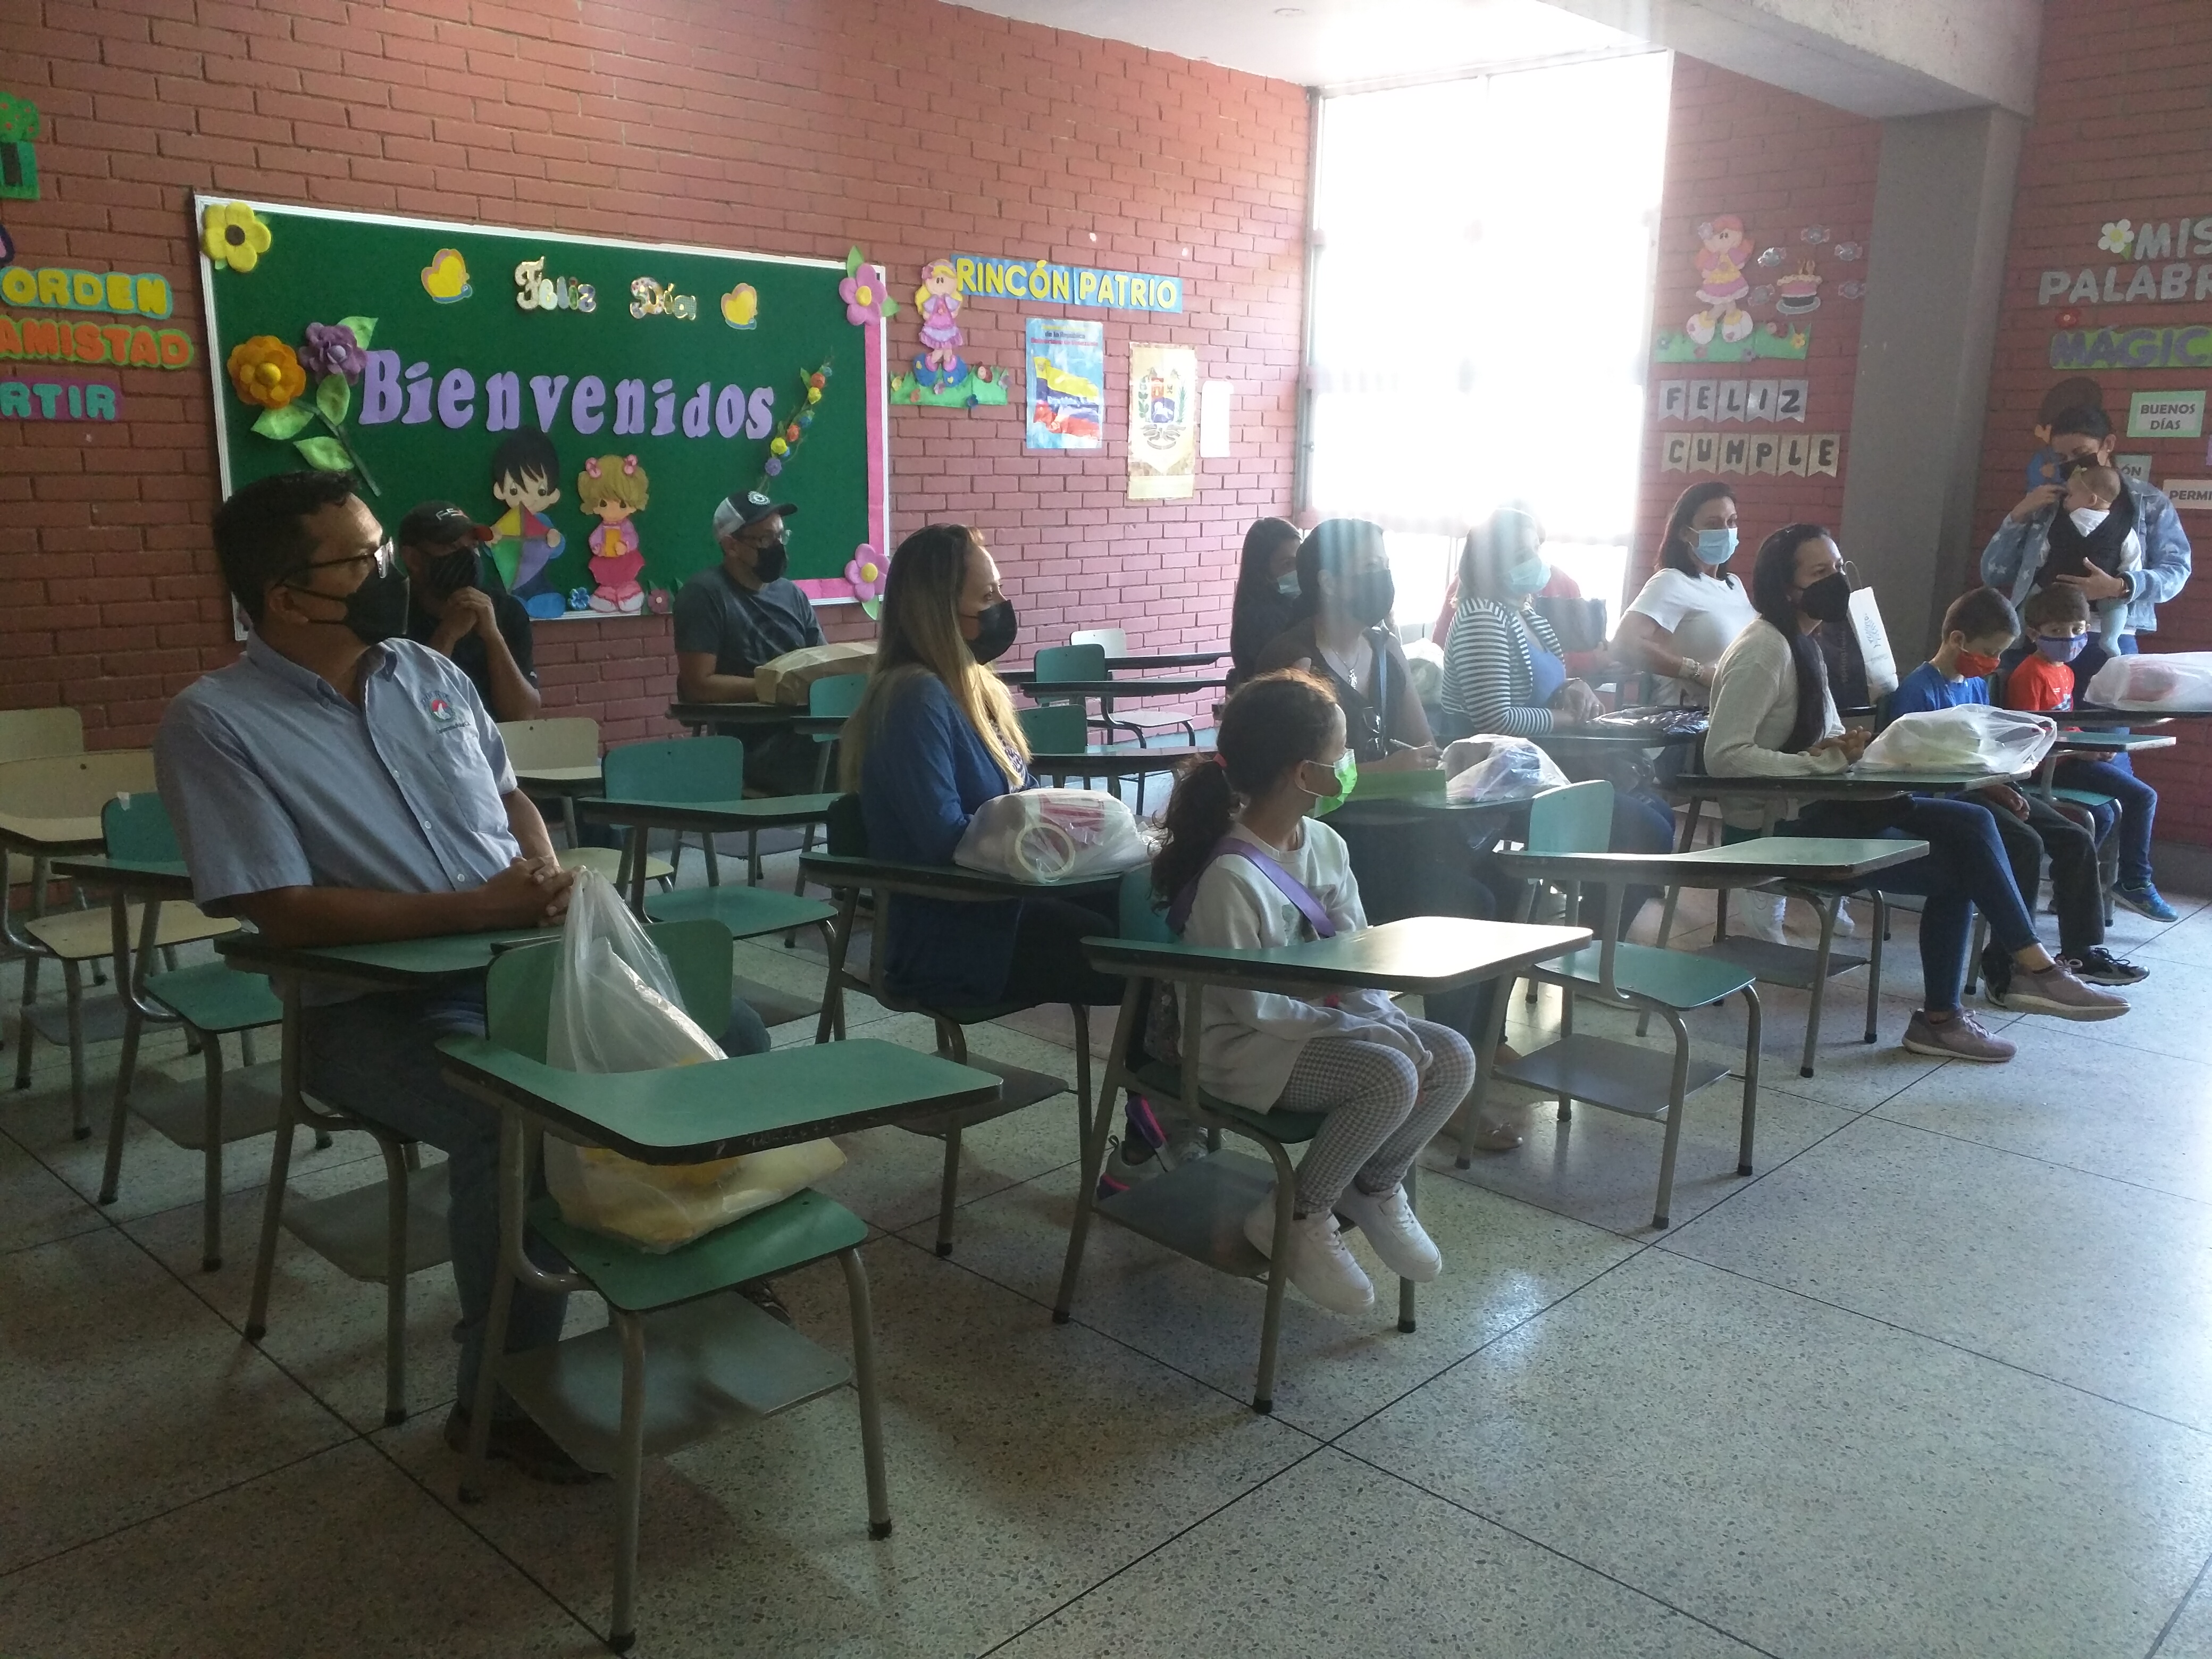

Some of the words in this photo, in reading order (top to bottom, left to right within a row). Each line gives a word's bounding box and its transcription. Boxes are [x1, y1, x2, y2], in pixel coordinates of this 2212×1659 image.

[2134, 217, 2212, 259] MIS
[3, 268, 166, 315] ORDEN
[515, 256, 597, 313] Feliz
[956, 258, 1069, 301] RINCÓN
[1079, 271, 1177, 308] PATRIO
[0, 318, 190, 365] AMISTAD
[358, 349, 775, 440] Bienvenidos
[1666, 386, 1800, 413] FELIZ
[2141, 404, 2196, 415] BUENOS
[2150, 418, 2181, 430] DÍAS
[1669, 439, 1835, 469] CUMPLE
